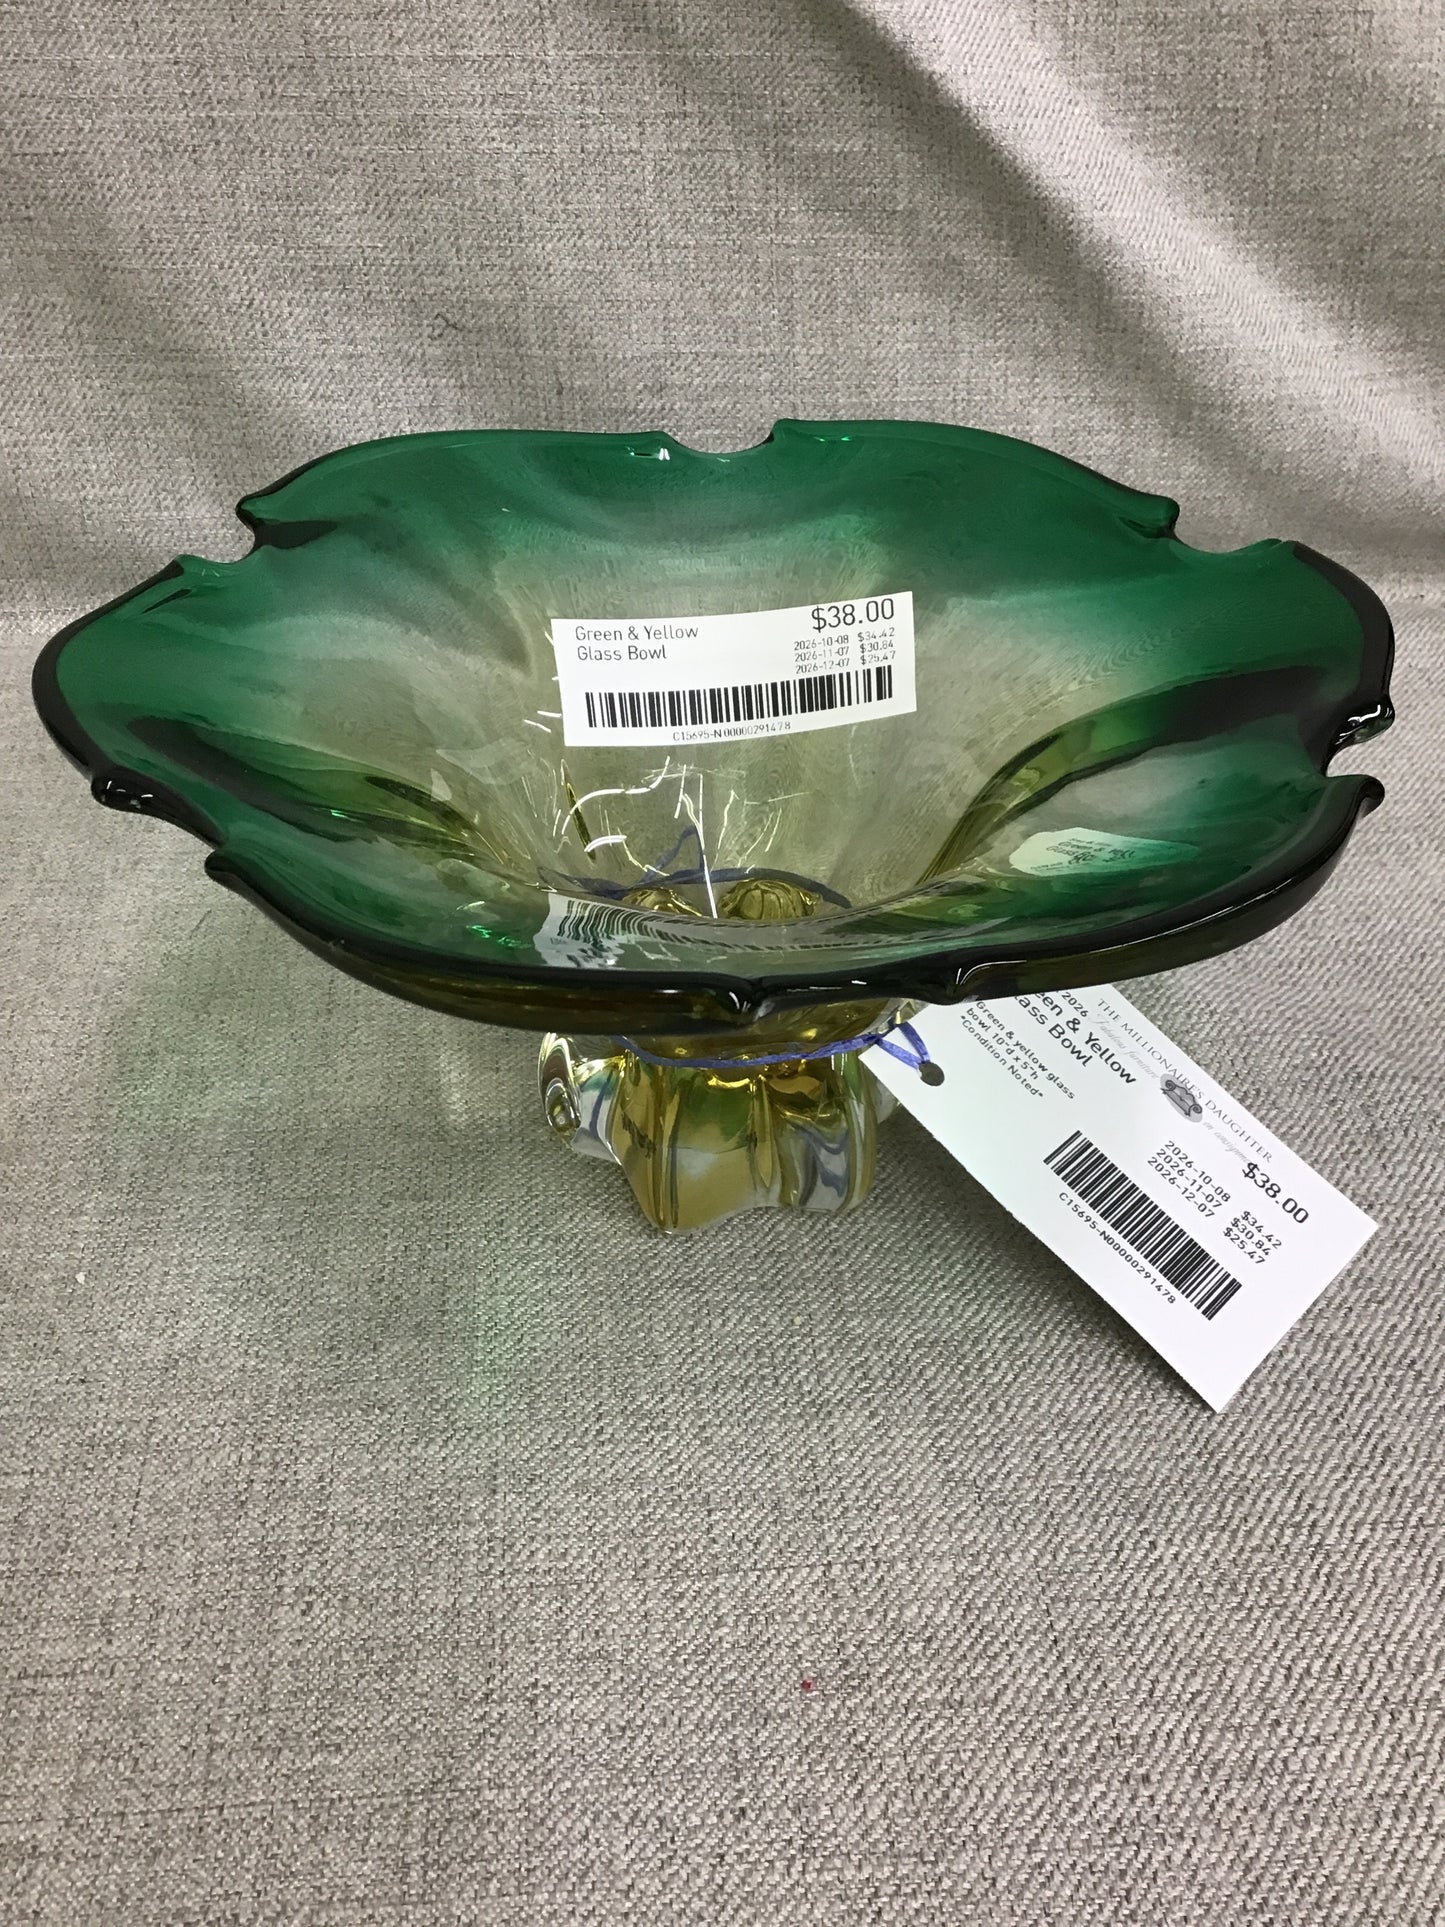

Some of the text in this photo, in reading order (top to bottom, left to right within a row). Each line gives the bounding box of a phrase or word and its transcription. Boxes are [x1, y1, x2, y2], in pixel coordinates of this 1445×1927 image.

[575, 624, 699, 641] Green & Yellow
[793, 627, 895, 651] 2026-10-08 $34.42
[811, 598, 894, 633] $38.00
[577, 644, 667, 661] Glass Bowl
[795, 639, 894, 662] 2026-11-07 $30.84
[796, 658, 850, 674] 2026-12-07
[966, 1007, 991, 1033] bowl
[1034, 992, 1137, 1084] een & Yellow
[1048, 1023, 1093, 1067] Bowl
[976, 1000, 1076, 1099] Green & yellow glass
[1097, 998, 1273, 1164] THE MILLIONAIRE'S DAUGHTER
[1147, 1156, 1266, 1265] 2026-12-07 $25.47
[1156, 1148, 1271, 1257] 2026-11-07 $30.84
[1165, 1140, 1282, 1250] 2026-10-08 $34.42
[1241, 1162, 1309, 1224] $38.00
[1059, 1192, 1176, 1304] C15695-N00000291478
